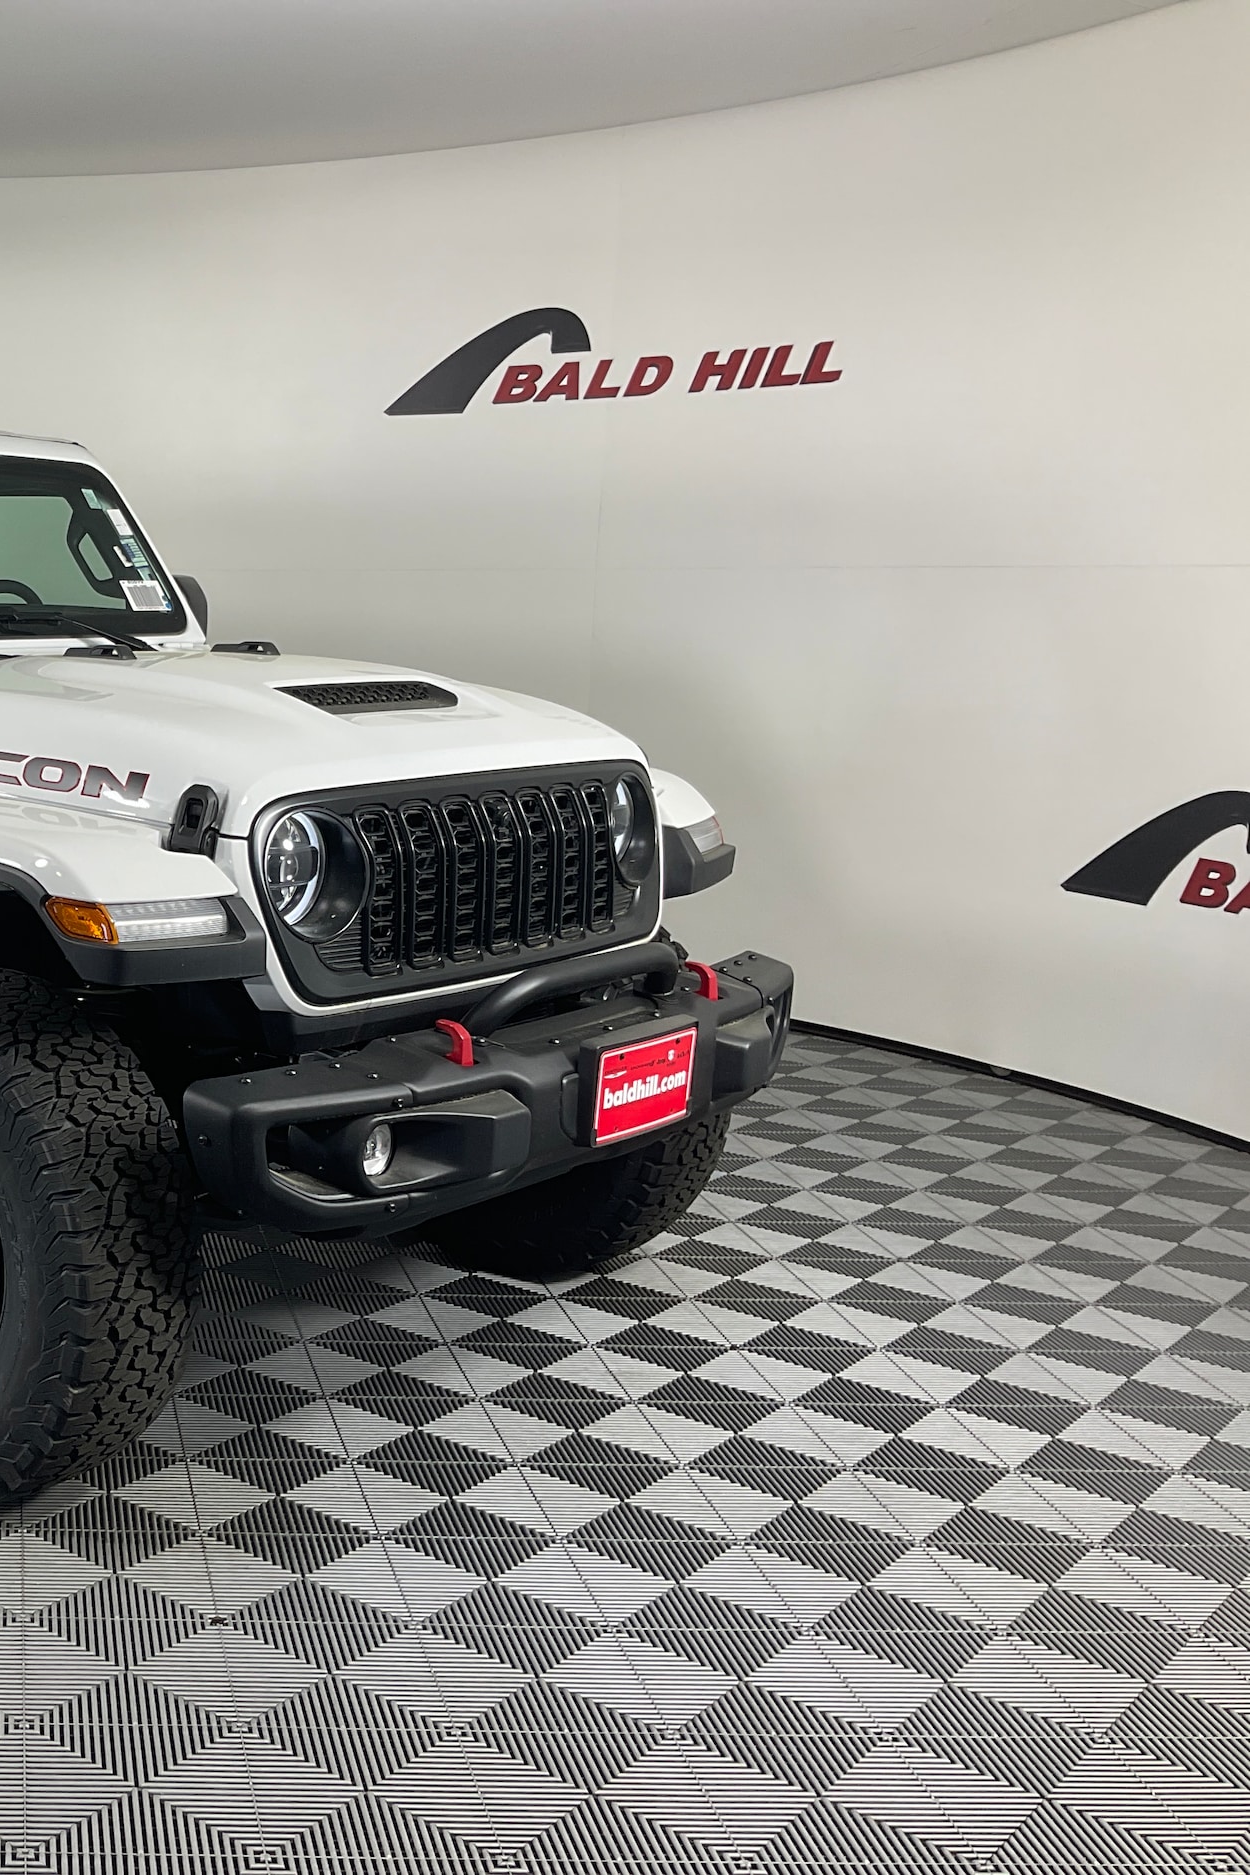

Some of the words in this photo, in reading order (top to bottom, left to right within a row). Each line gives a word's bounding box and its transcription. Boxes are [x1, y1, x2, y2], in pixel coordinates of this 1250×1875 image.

[492, 355, 674, 404] BALD
[688, 340, 843, 393] HILL
[602, 1070, 687, 1110] baldhill.com
